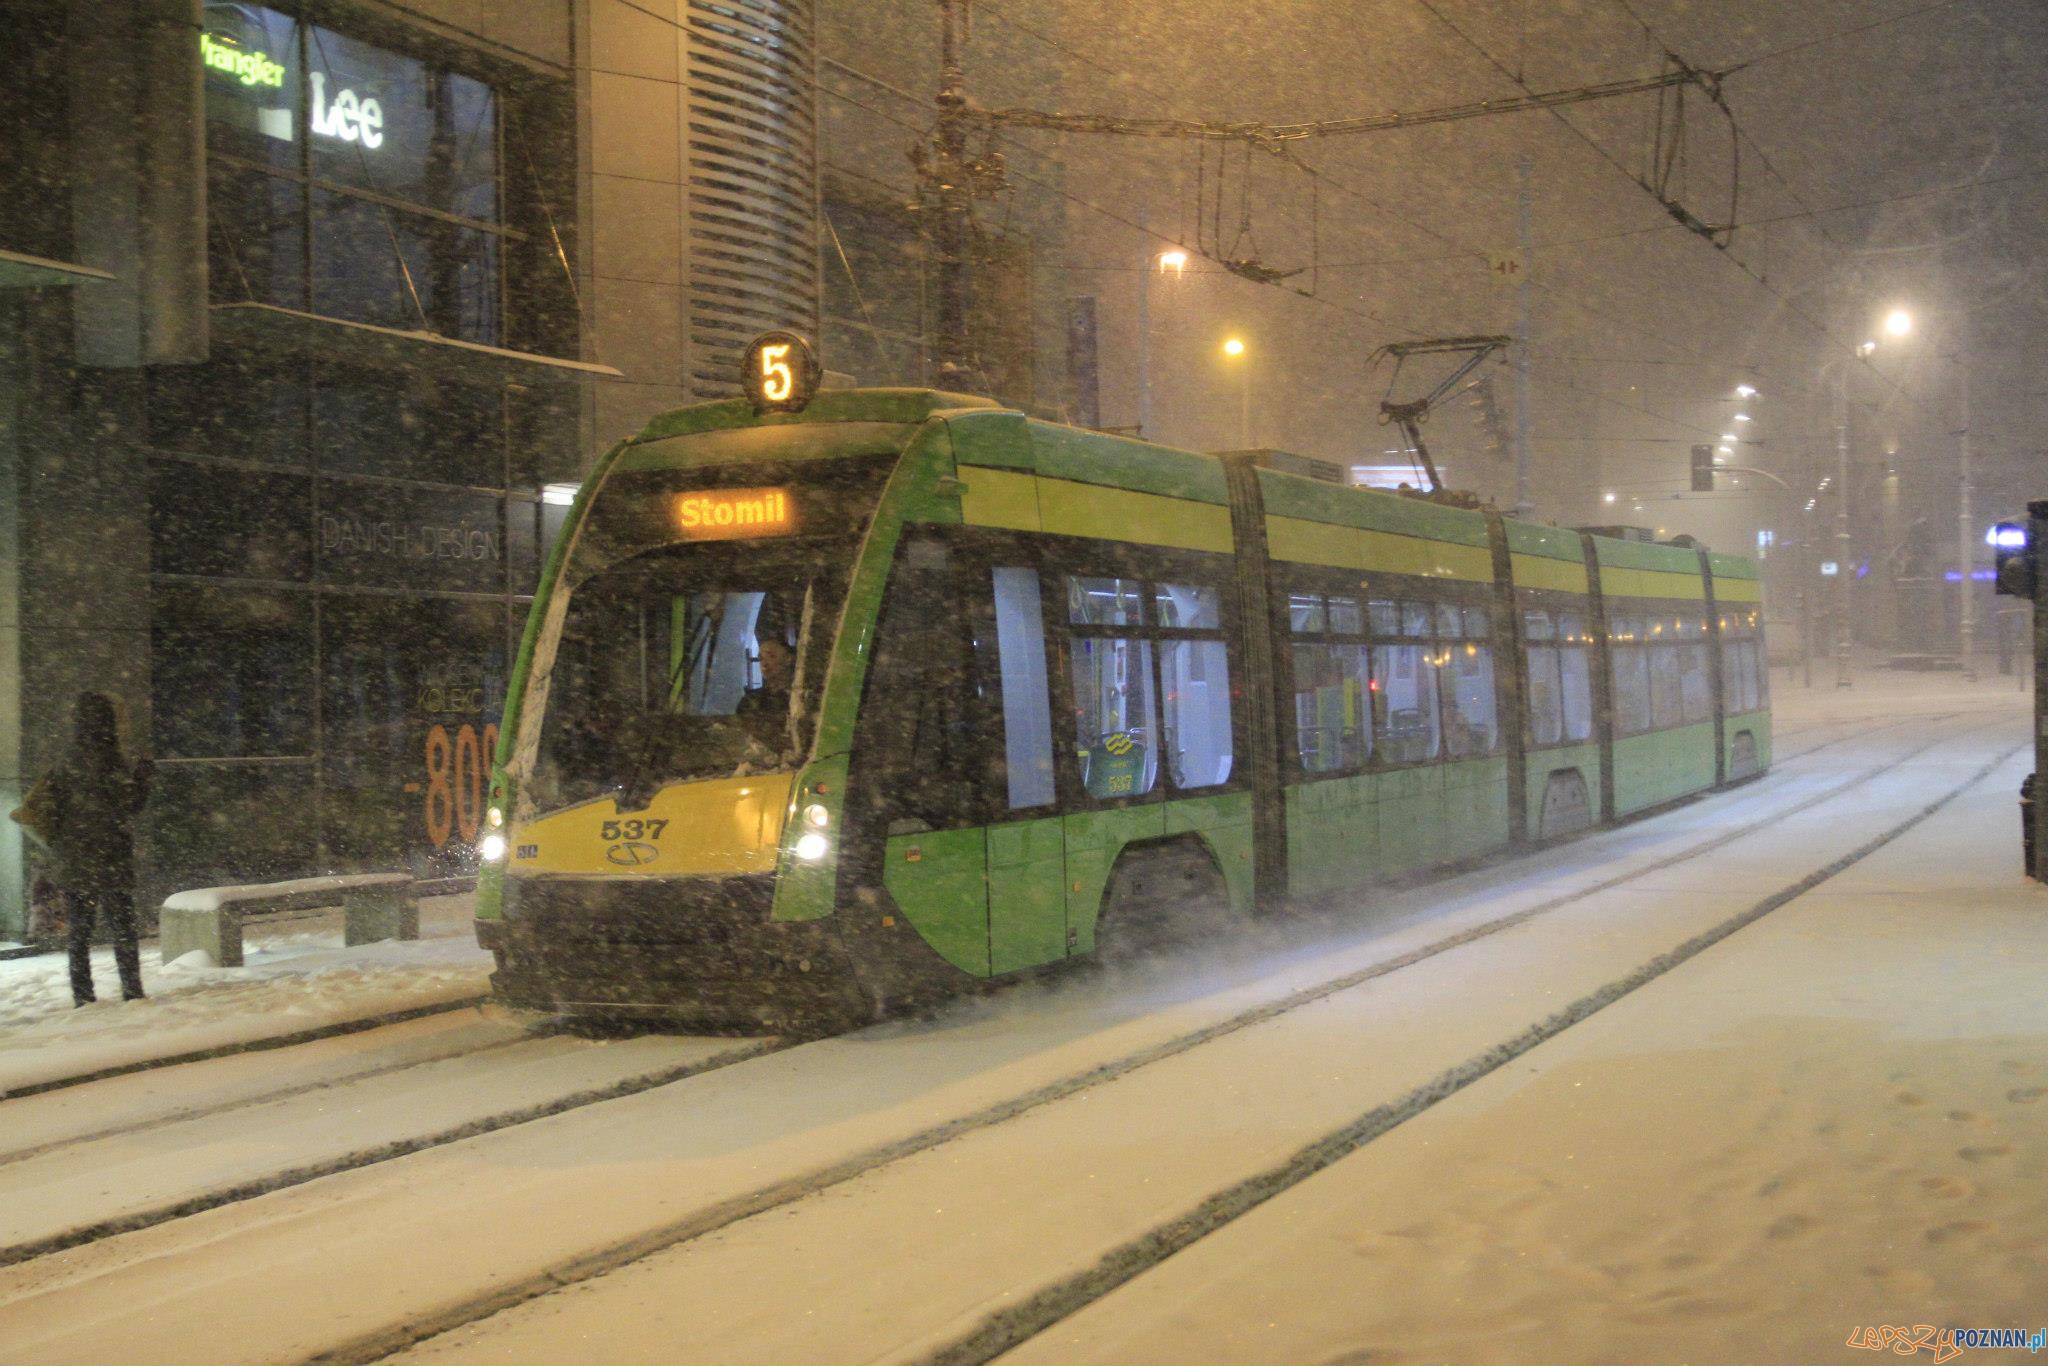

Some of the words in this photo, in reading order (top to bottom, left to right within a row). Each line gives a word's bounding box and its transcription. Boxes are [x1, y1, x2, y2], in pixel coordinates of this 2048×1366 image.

[201, 34, 285, 87] rangler
[309, 71, 383, 149] Lee
[762, 345, 792, 401] 5
[681, 493, 785, 528] Stomil
[322, 517, 408, 562] DANISH
[421, 526, 501, 562] DESIGN
[601, 819, 669, 841] 537
